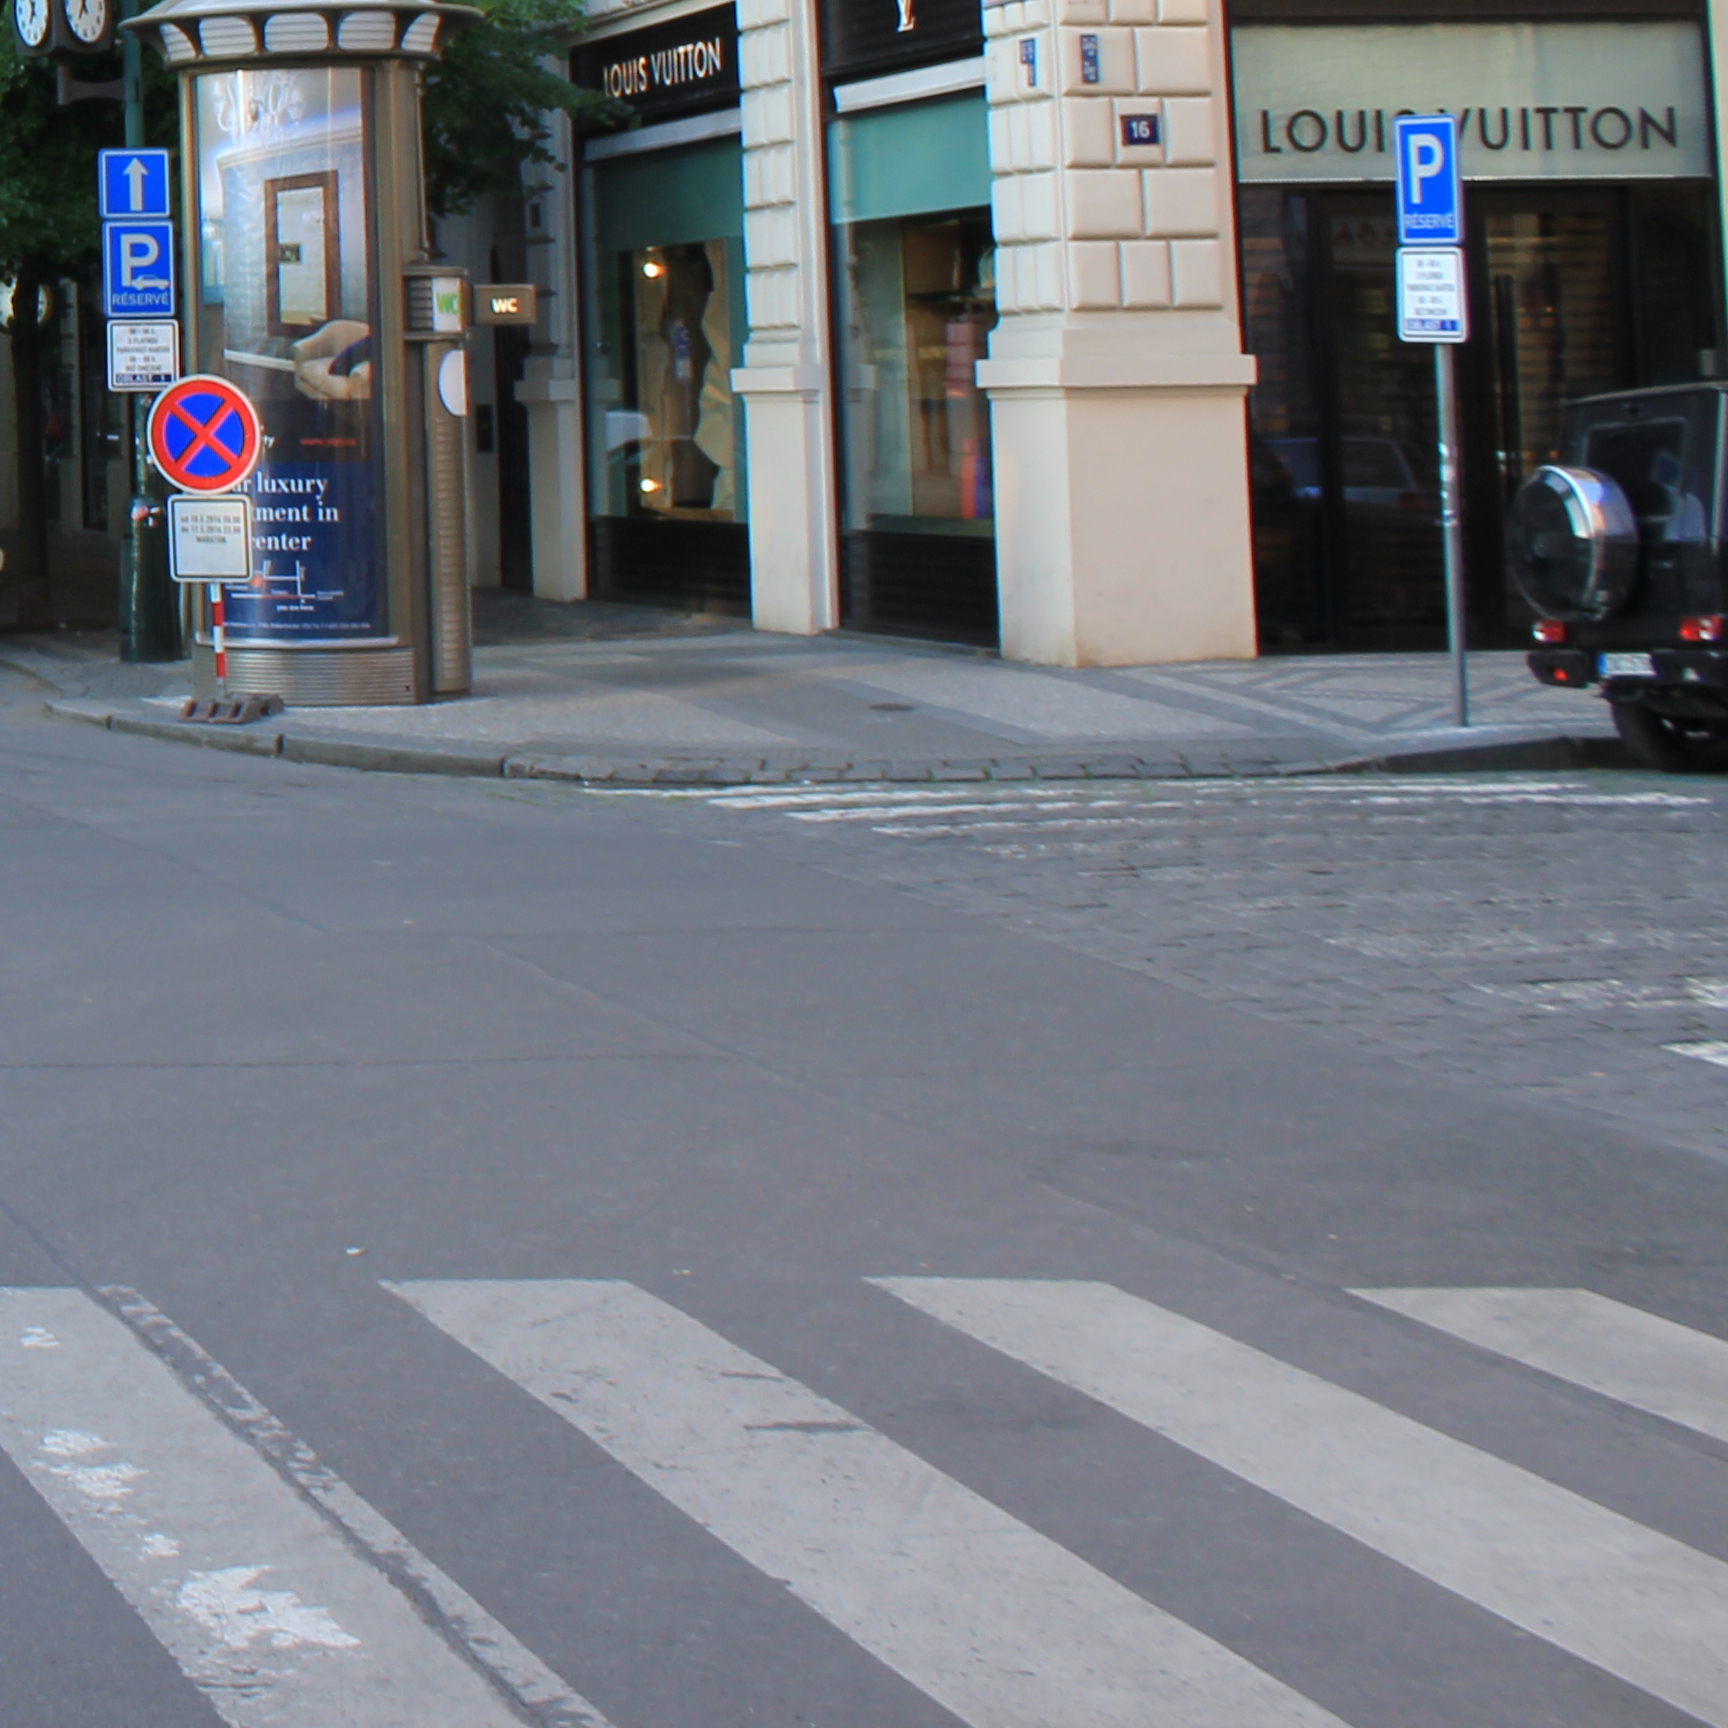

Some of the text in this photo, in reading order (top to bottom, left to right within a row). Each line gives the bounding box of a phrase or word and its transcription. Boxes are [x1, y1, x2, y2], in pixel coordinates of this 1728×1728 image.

[604, 36, 722, 98] LOUIS VUITTON
[1131, 121, 1150, 138] 16
[1261, 109, 1417, 153] LOUI
[1408, 133, 1444, 204] P
[121, 233, 159, 287] P
[112, 291, 169, 306] RÉSERVÉ
[491, 297, 520, 314] WC
[257, 471, 329, 500] luxury
[318, 500, 339, 522] in
